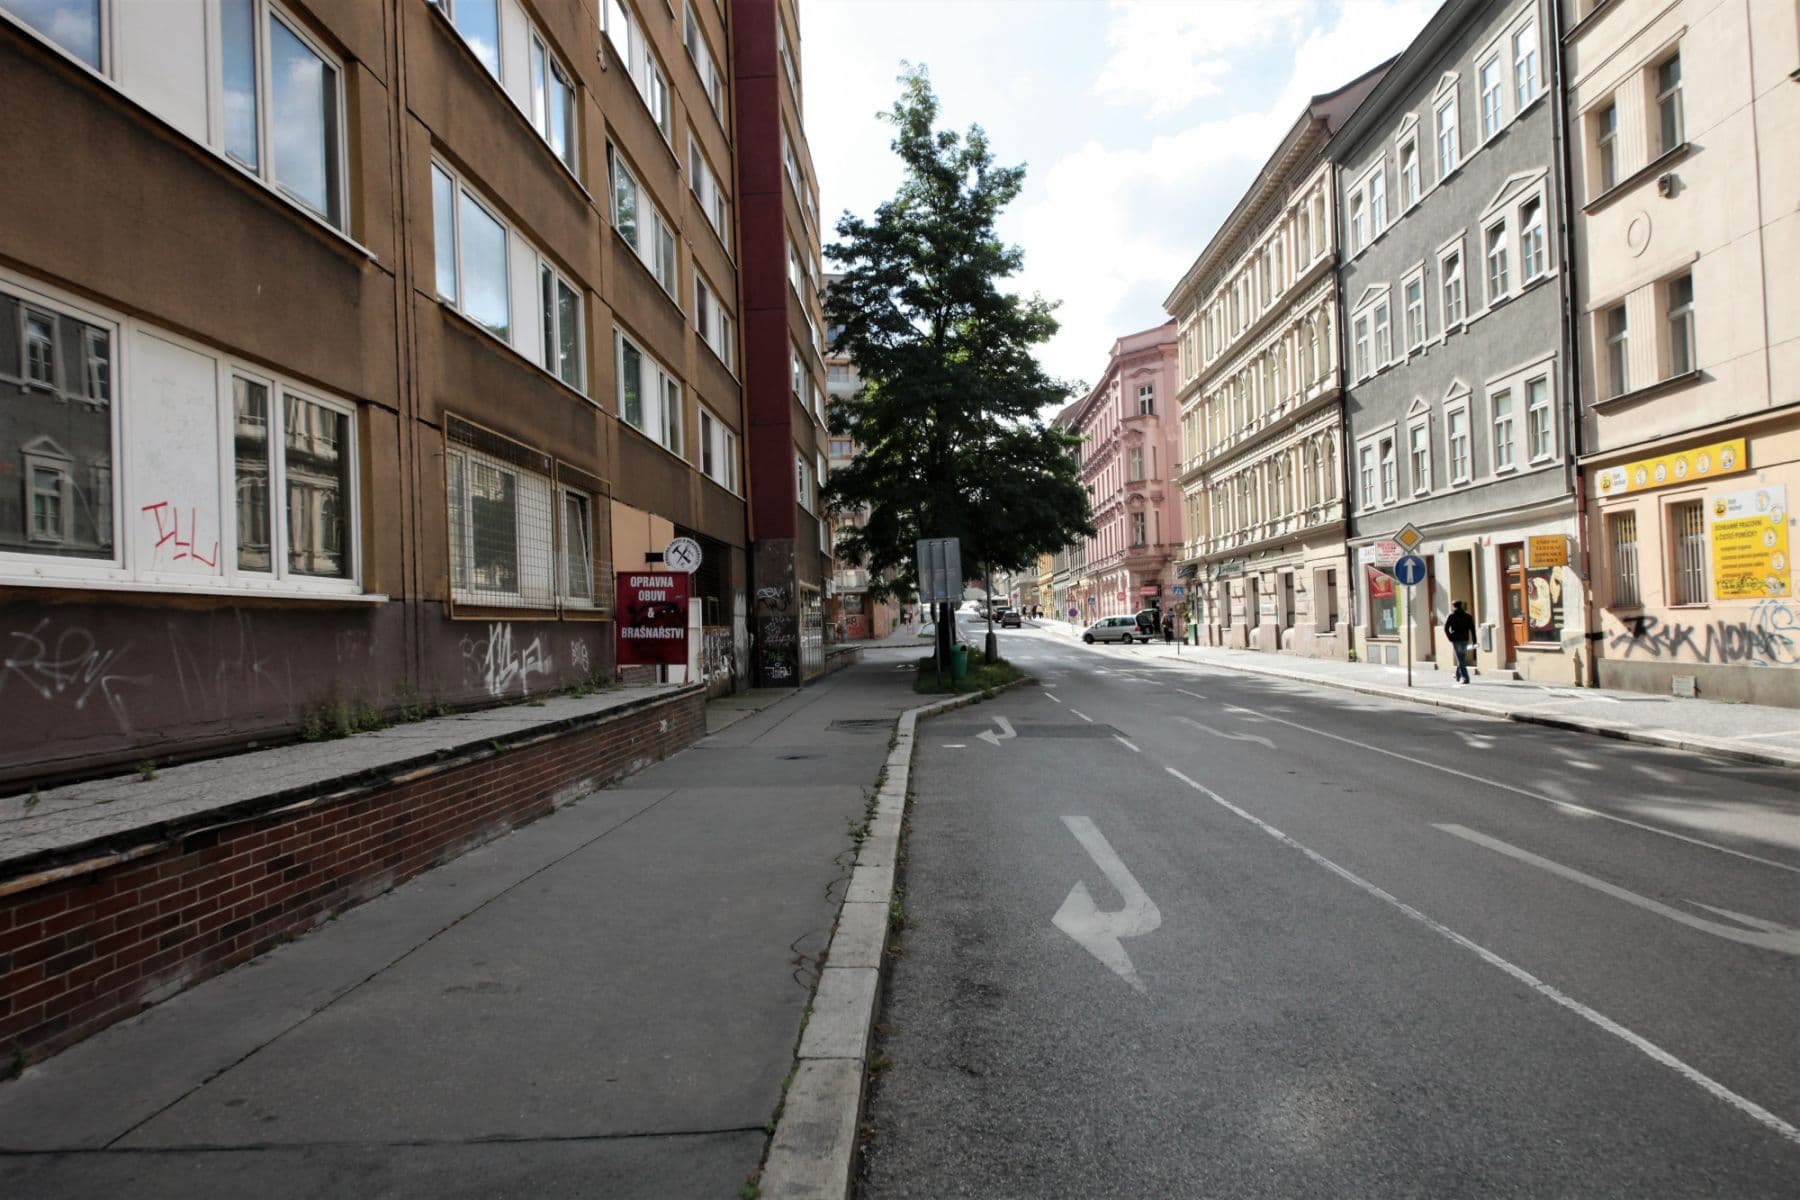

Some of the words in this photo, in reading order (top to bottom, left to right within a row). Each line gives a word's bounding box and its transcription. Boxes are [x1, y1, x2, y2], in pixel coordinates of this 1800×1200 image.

[630, 576, 674, 588] OPRAVNA
[638, 590, 666, 601] OBUVI
[647, 607, 655, 618] &
